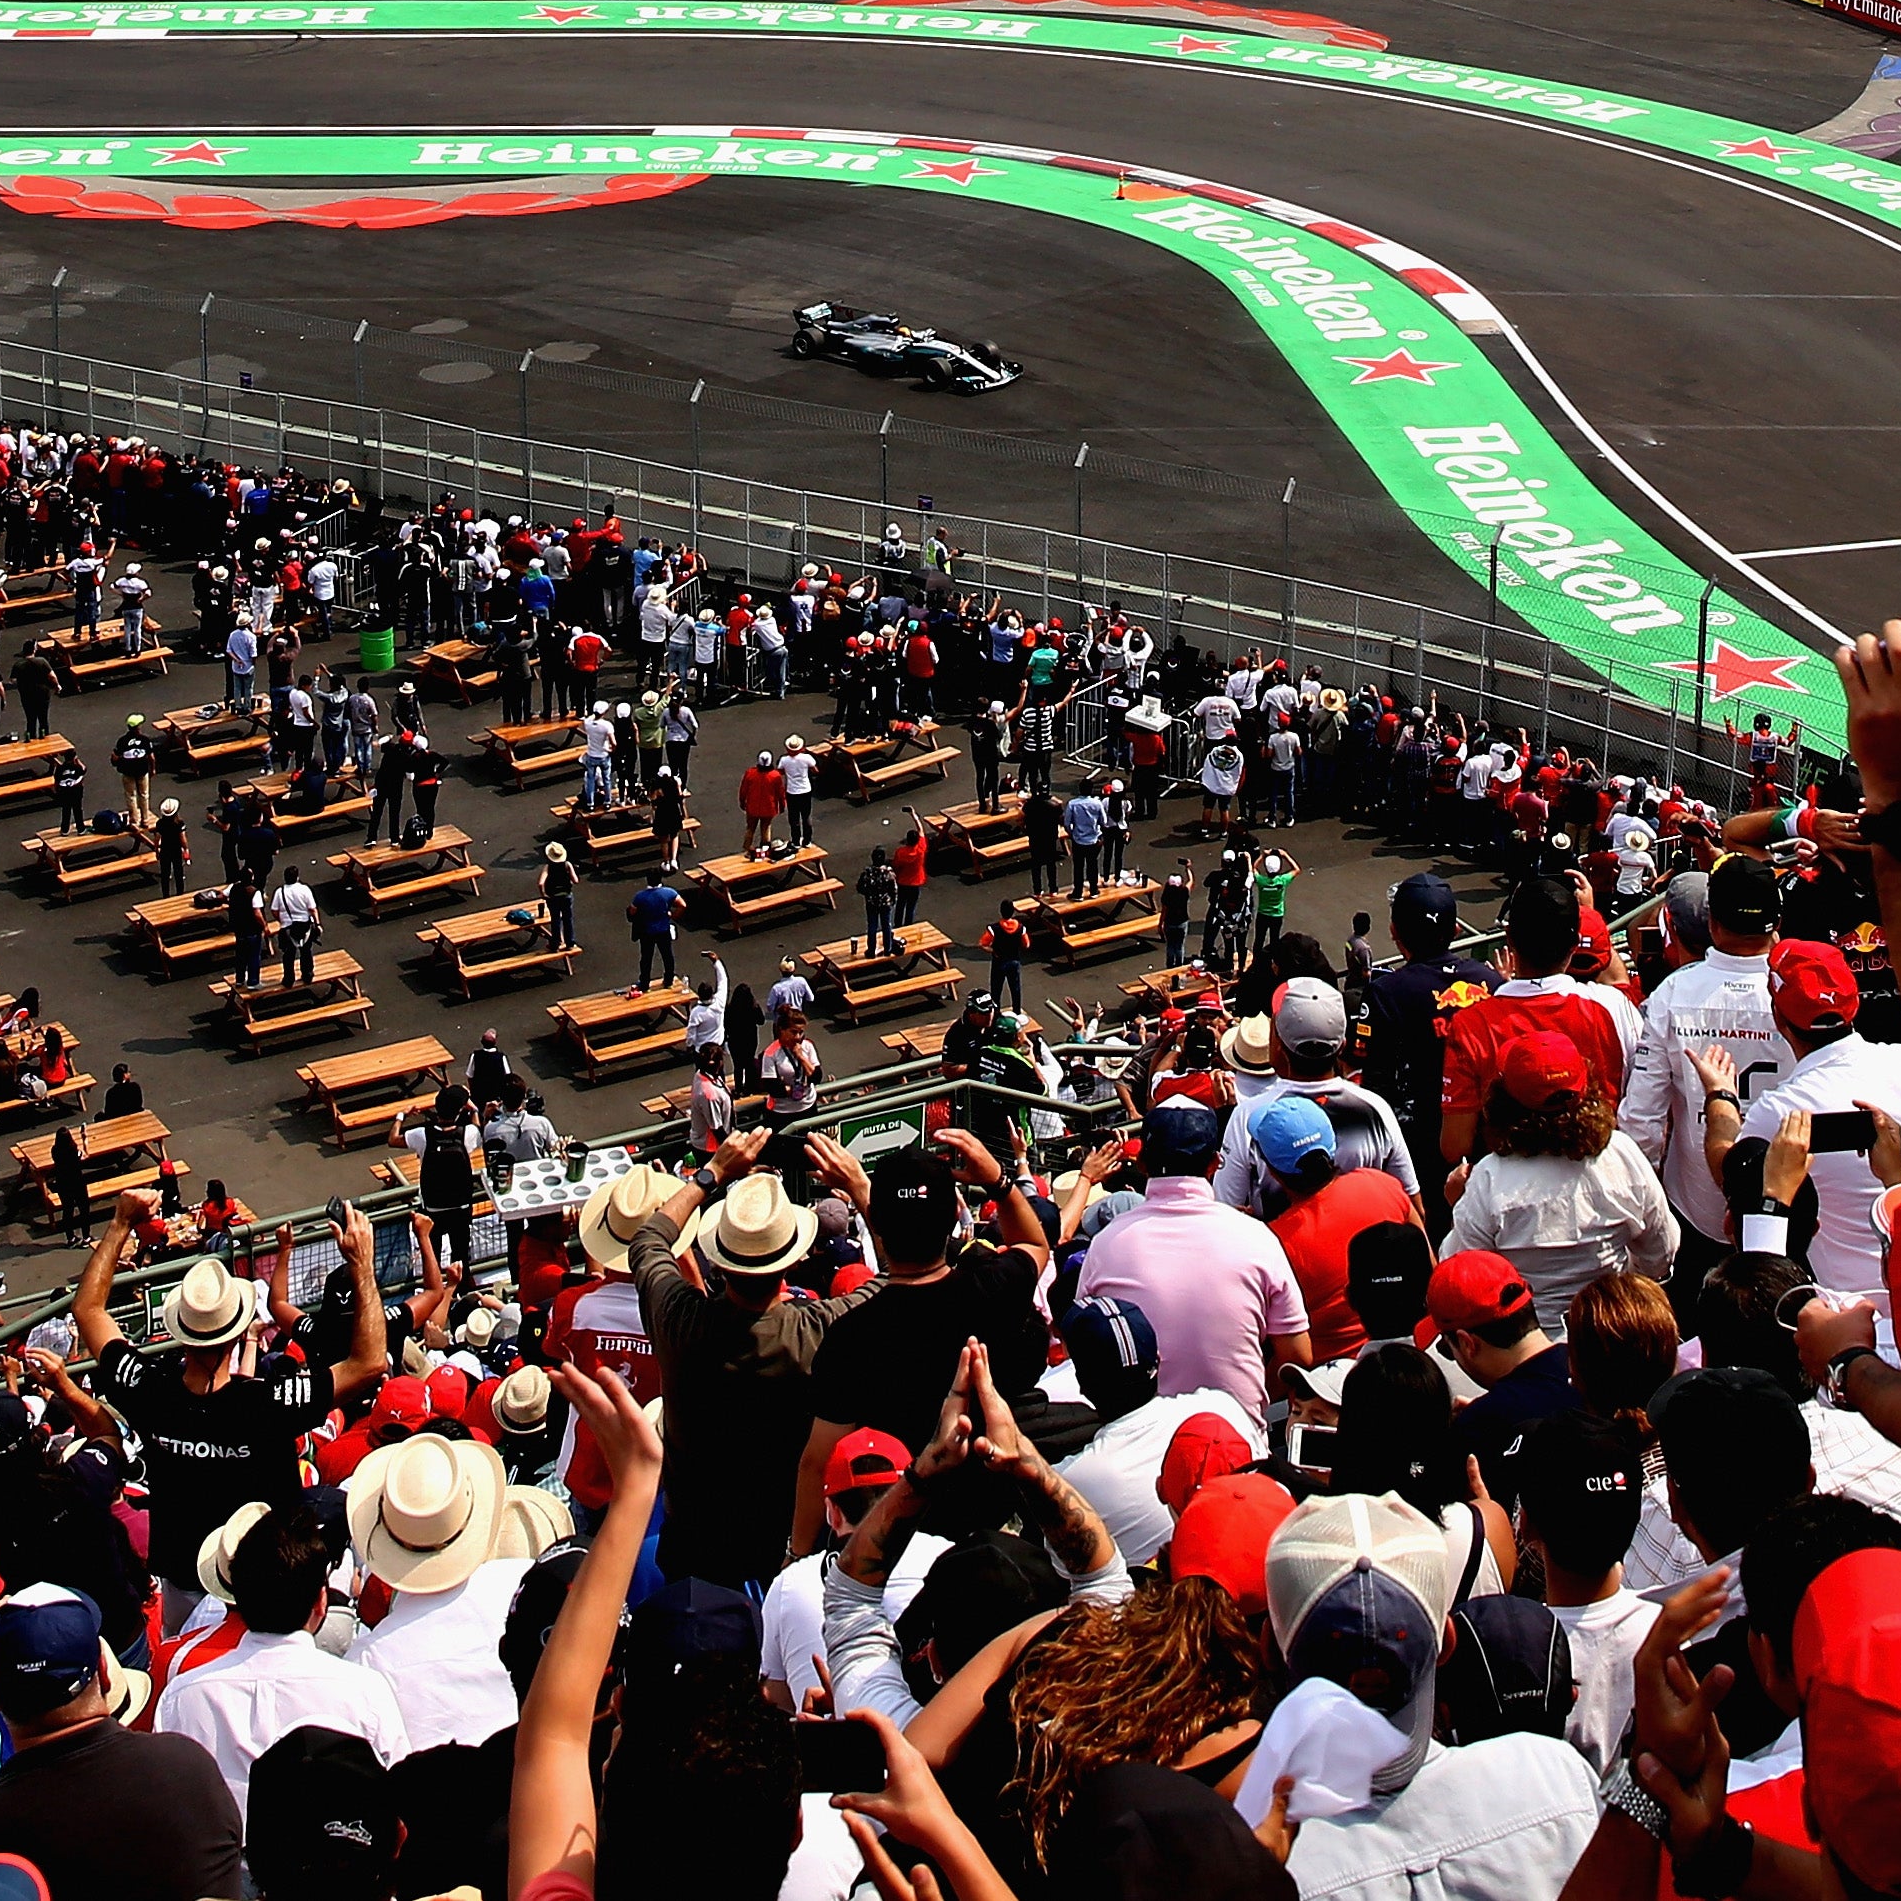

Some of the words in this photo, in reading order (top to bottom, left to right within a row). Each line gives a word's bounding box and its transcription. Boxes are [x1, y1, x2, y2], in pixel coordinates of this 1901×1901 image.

[636, 5, 1043, 40] Heineken
[1266, 46, 1653, 123] Heineken
[410, 142, 882, 172] Heineken
[1133, 201, 1389, 342] Heineken
[1402, 421, 1686, 637] Heineken
[1719, 1028, 1770, 1041] MARTINI
[863, 1122, 886, 1136] RUTA
